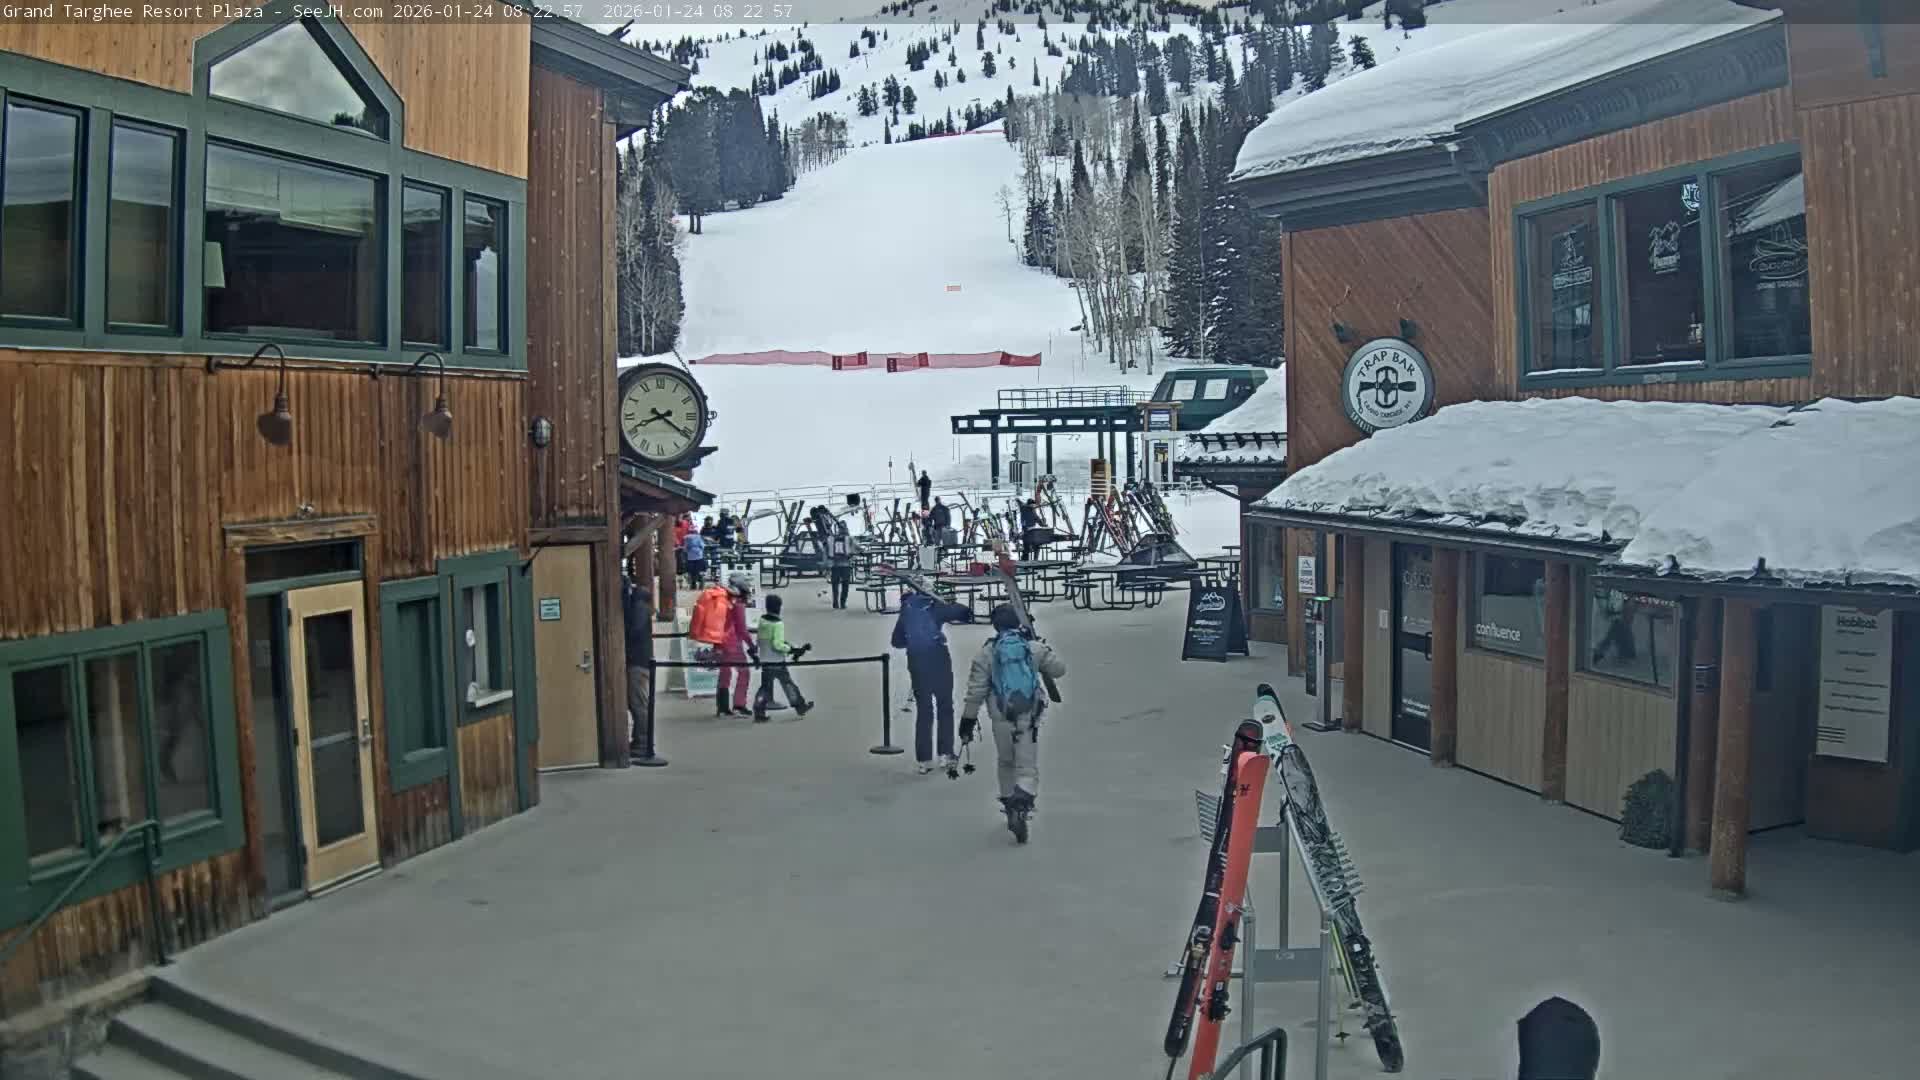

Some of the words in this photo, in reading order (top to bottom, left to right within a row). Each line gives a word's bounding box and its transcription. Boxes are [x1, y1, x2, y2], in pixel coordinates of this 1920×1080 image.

[1357, 350, 1387, 378] TRAP
[1392, 352, 1415, 376] BAR
[1476, 622, 1521, 642] confluence
